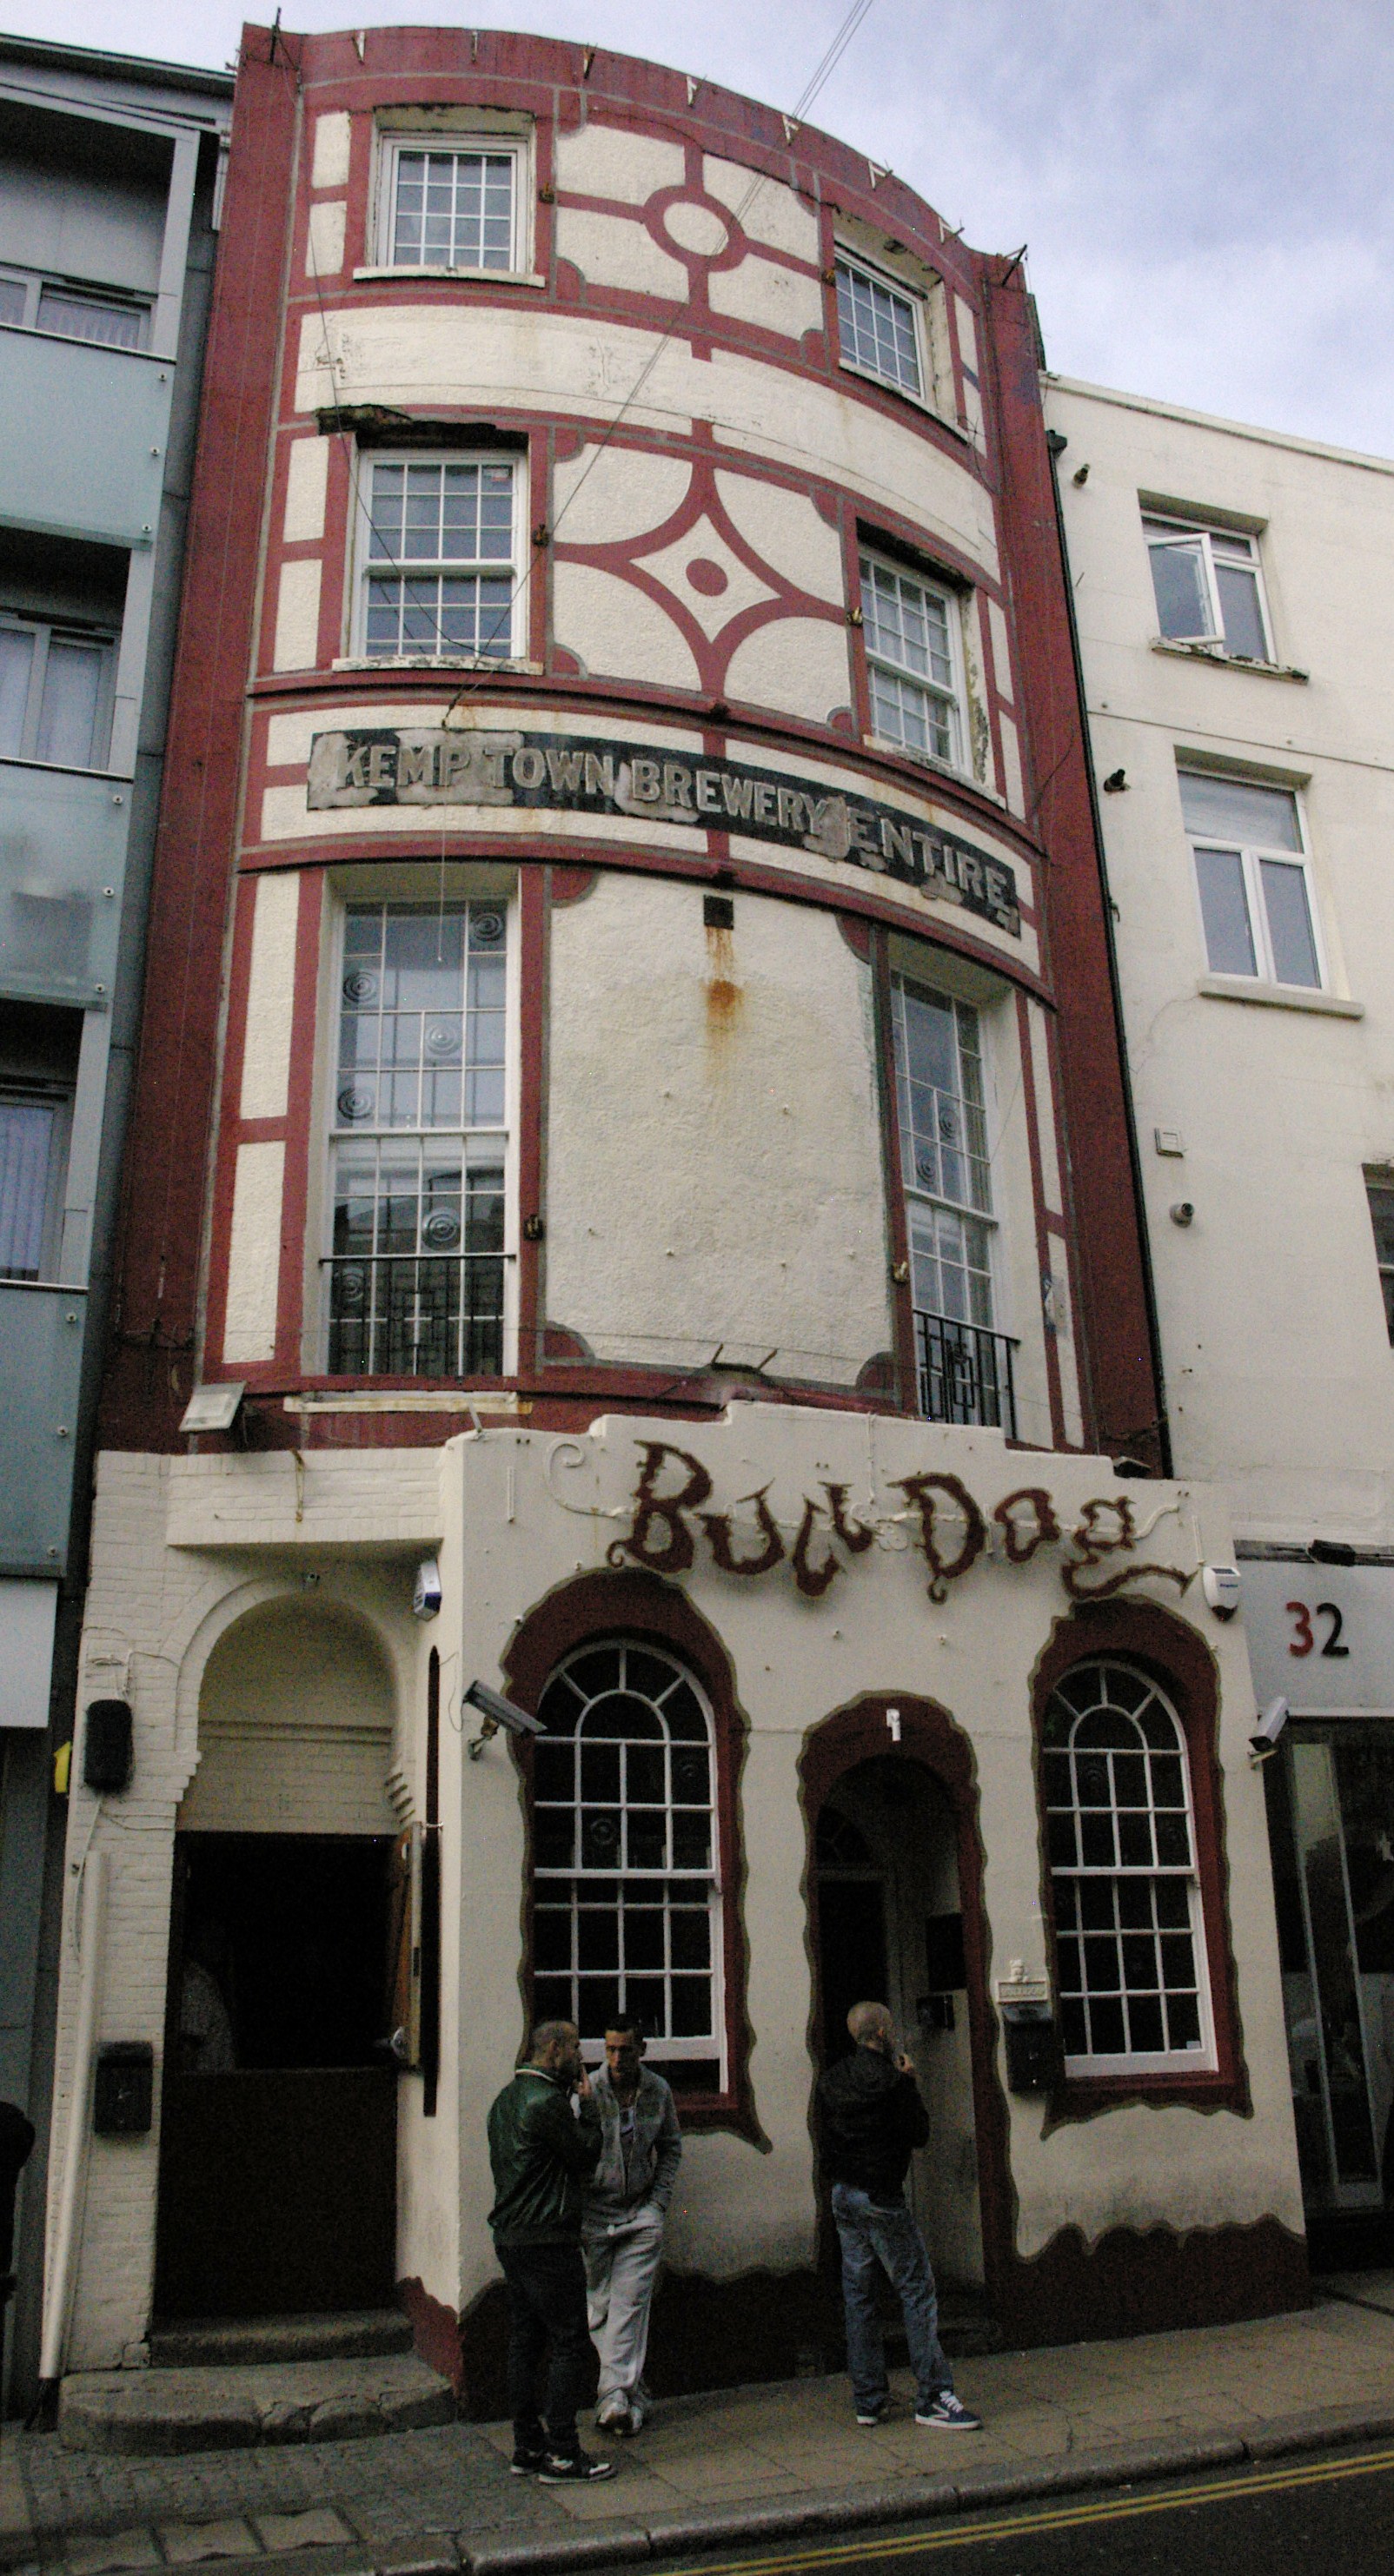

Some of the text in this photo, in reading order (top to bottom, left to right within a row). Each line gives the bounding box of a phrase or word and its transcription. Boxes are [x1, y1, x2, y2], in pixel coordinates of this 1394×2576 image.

[335, 744, 1015, 916] KEMP TOWN BREWERY ENTIRE
[1285, 1601, 1350, 1658] 32
